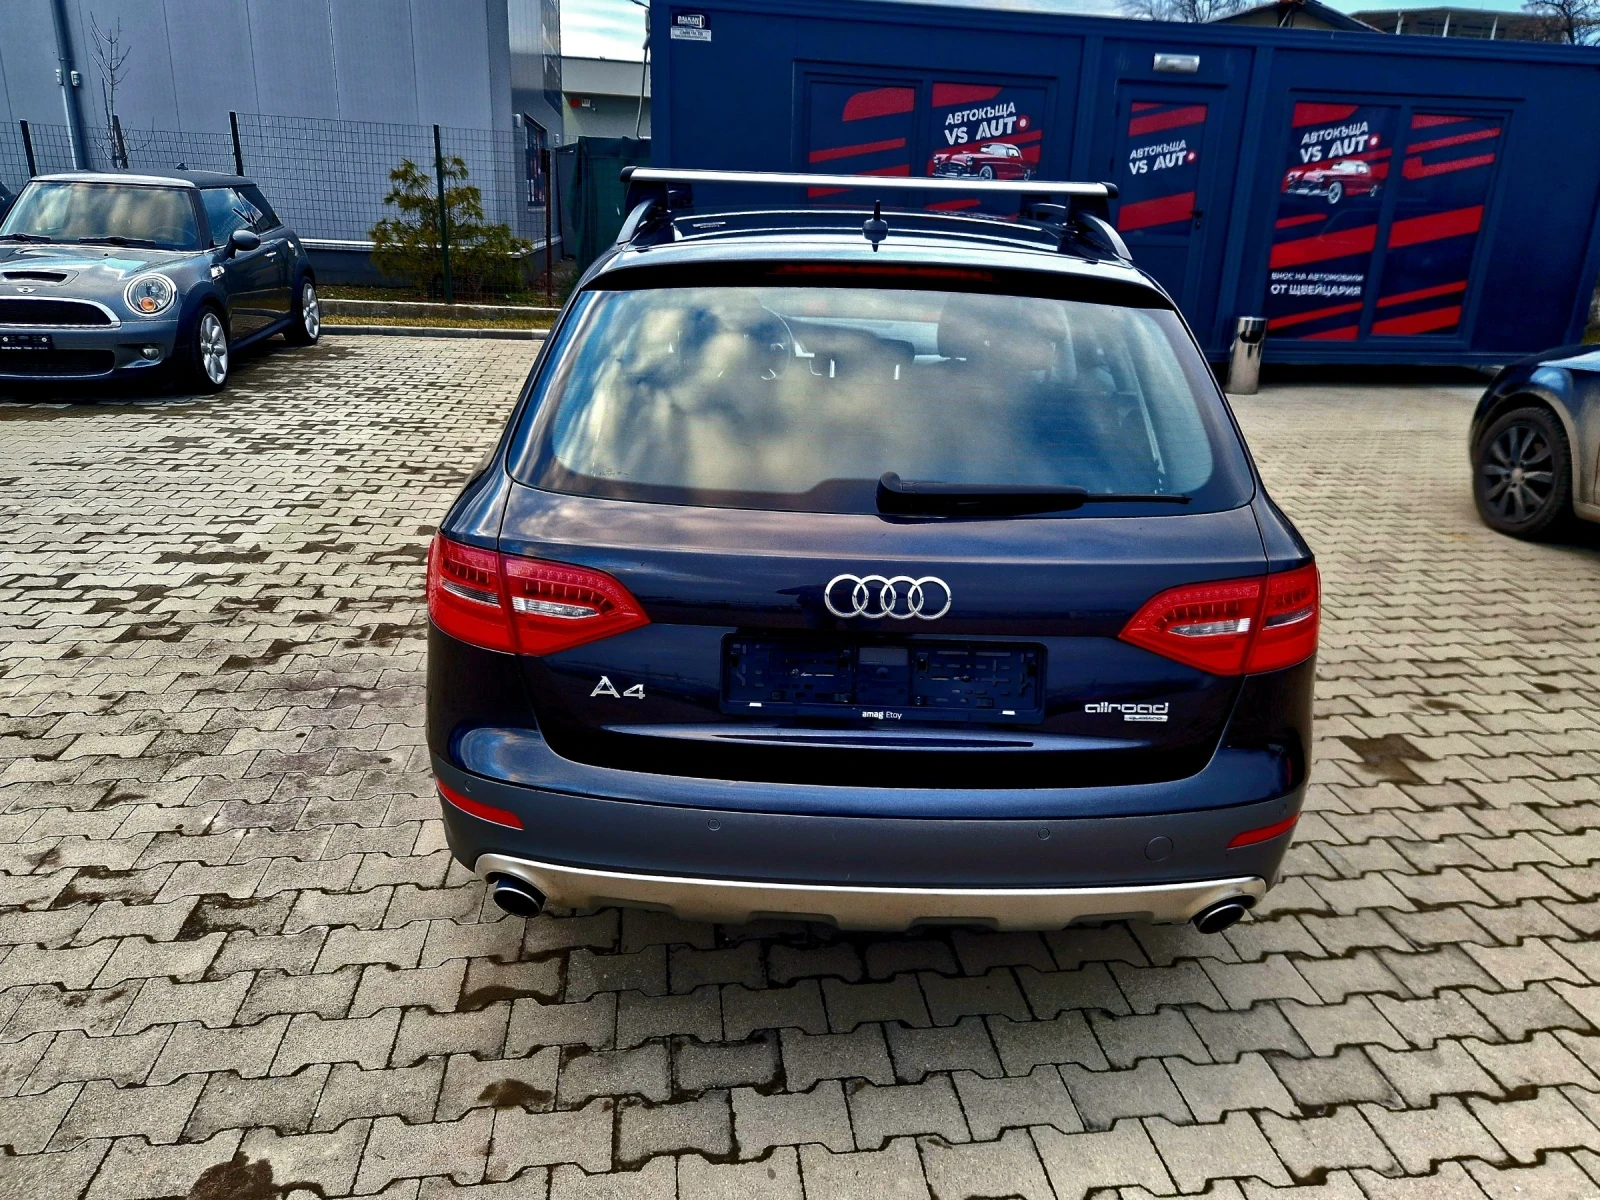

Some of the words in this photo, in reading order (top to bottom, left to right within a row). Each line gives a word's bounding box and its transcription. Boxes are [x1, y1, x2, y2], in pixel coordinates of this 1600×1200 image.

[945, 102, 1016, 126] АВТОКЪЩА
[944, 127, 968, 145] VS
[1301, 121, 1369, 145] АВТОКЪЩА
[1129, 139, 1187, 160] АВТОКЪЩА
[1300, 146, 1322, 163] VS
[1129, 160, 1148, 175] VS
[1270, 284, 1288, 294] ОТ
[590, 675, 645, 699] A4
[862, 711, 883, 719] amag
[886, 711, 902, 720] Etoy
[1084, 702, 1169, 713] allroad
